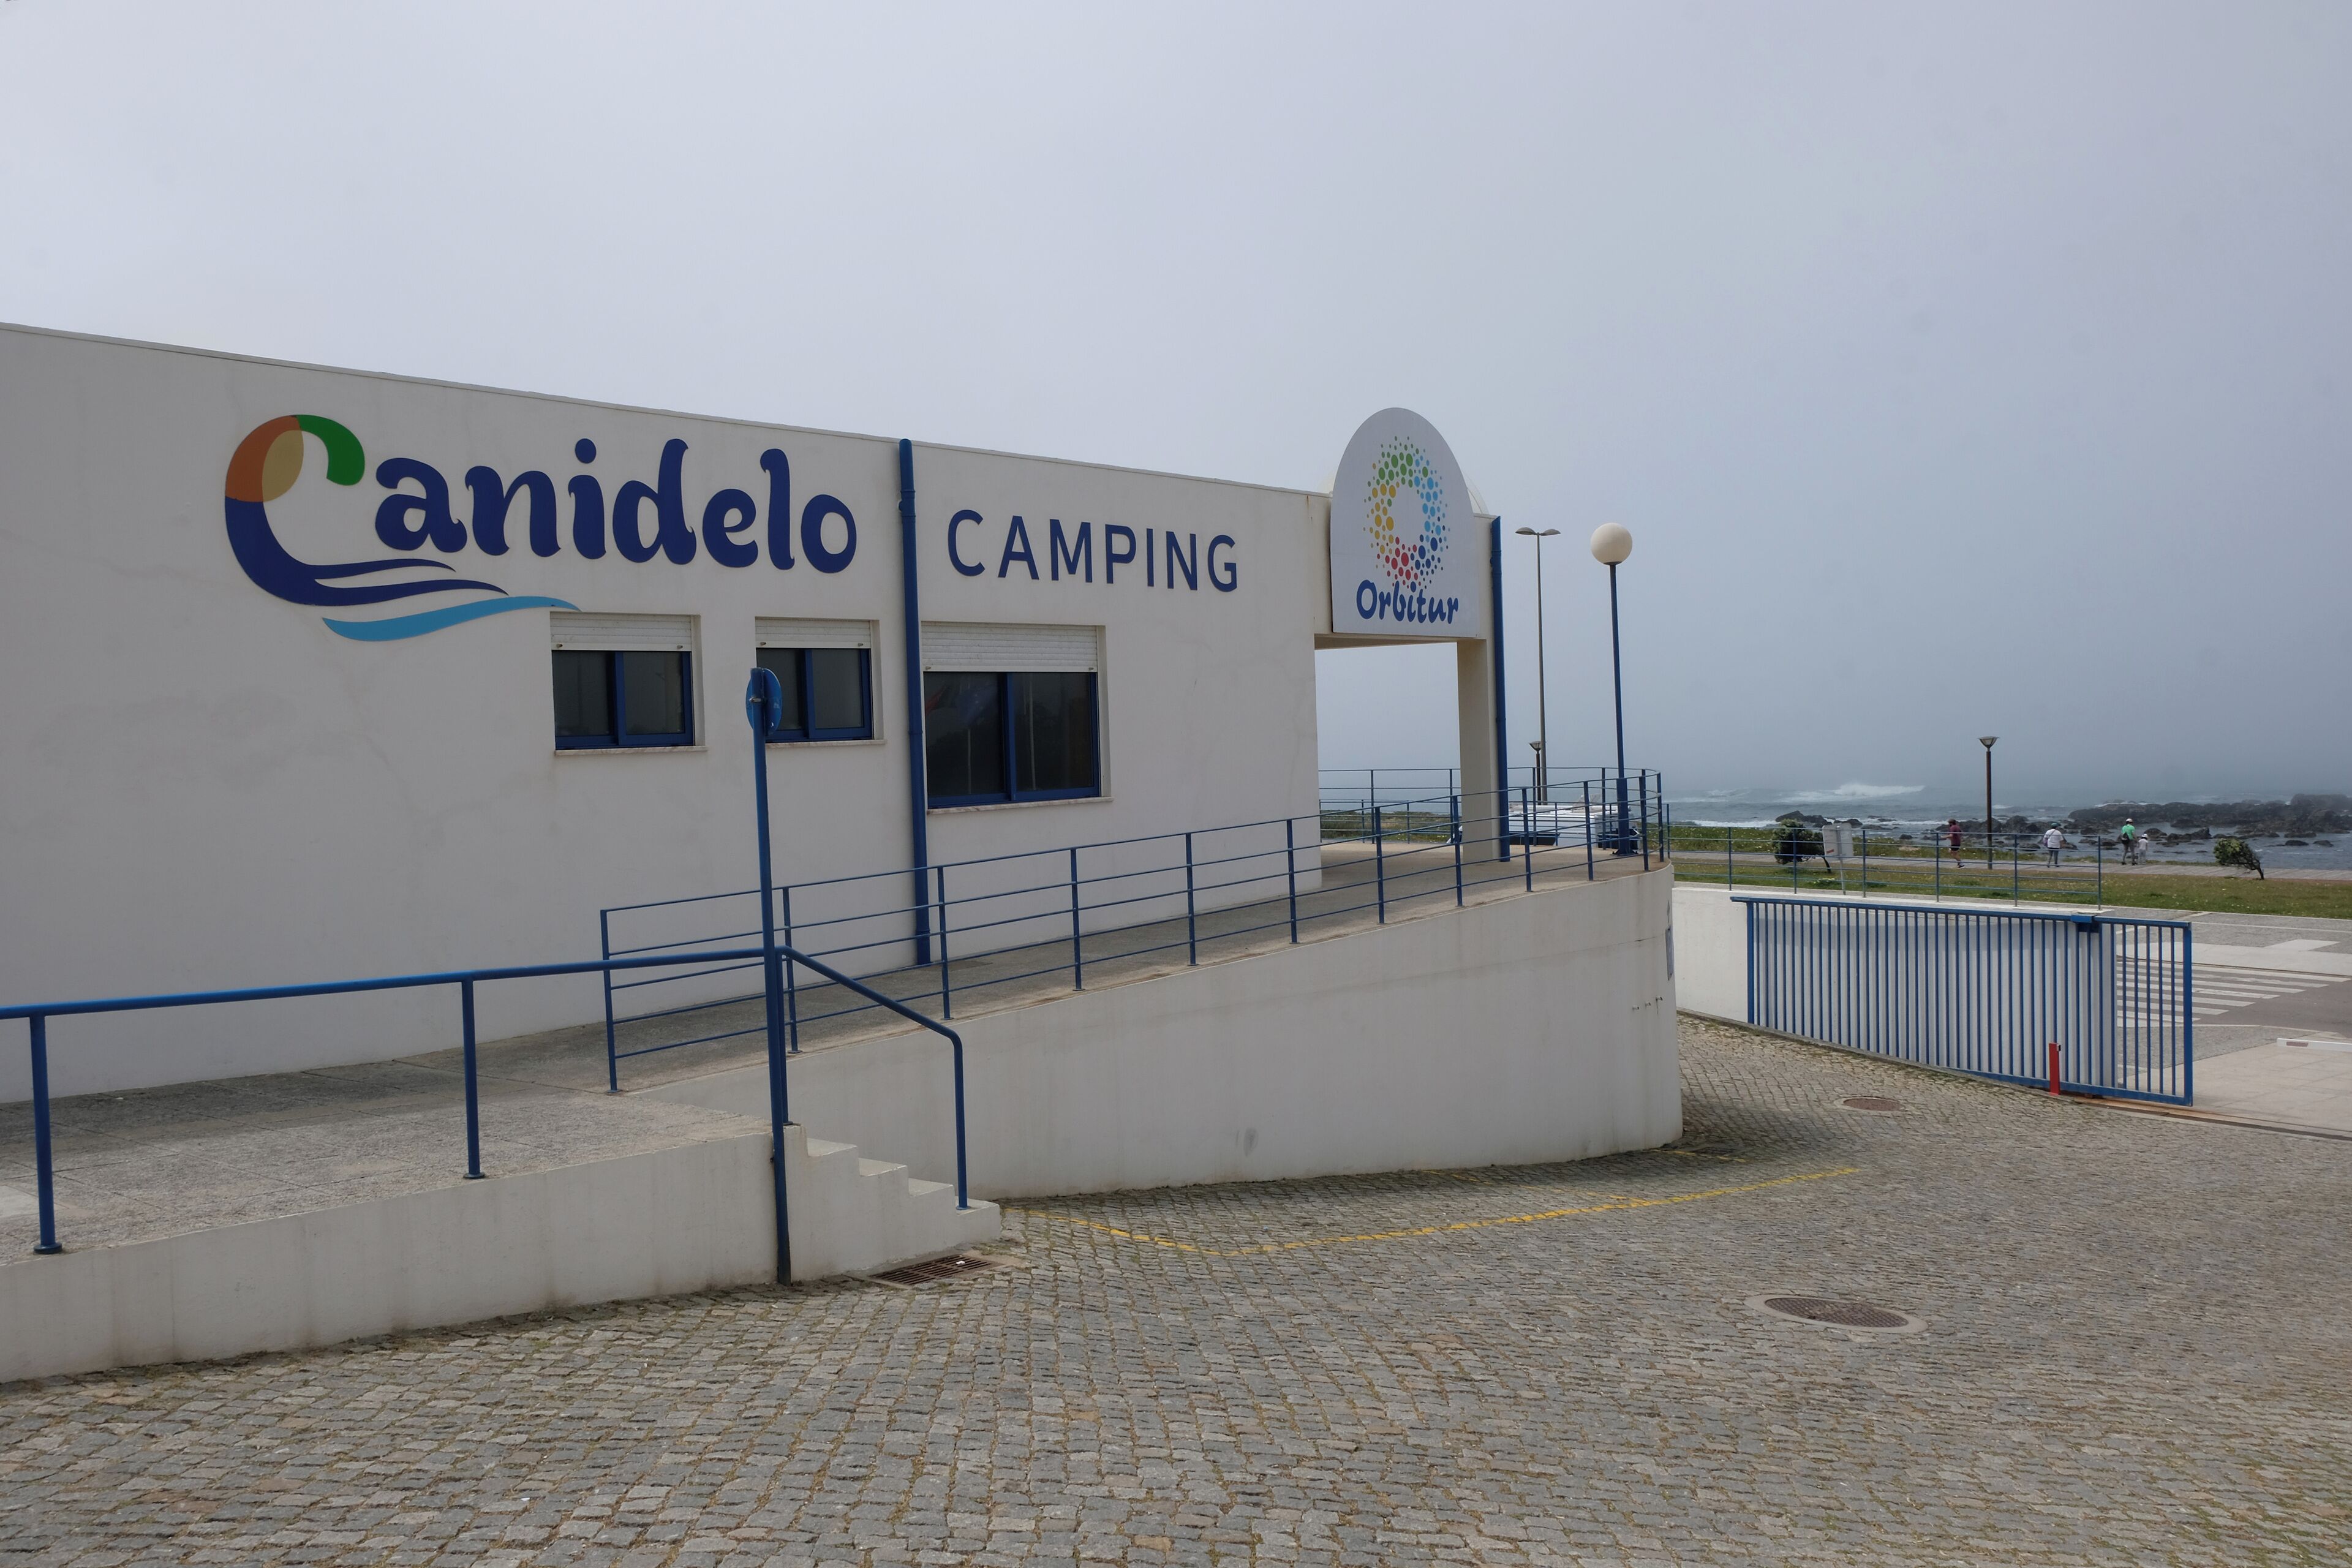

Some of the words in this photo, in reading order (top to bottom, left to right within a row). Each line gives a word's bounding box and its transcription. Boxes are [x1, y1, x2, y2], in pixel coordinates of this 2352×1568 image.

[225, 414, 857, 605] Canidelo
[948, 510, 1237, 592] CAMPING
[1356, 579, 1459, 624] Orbitur
